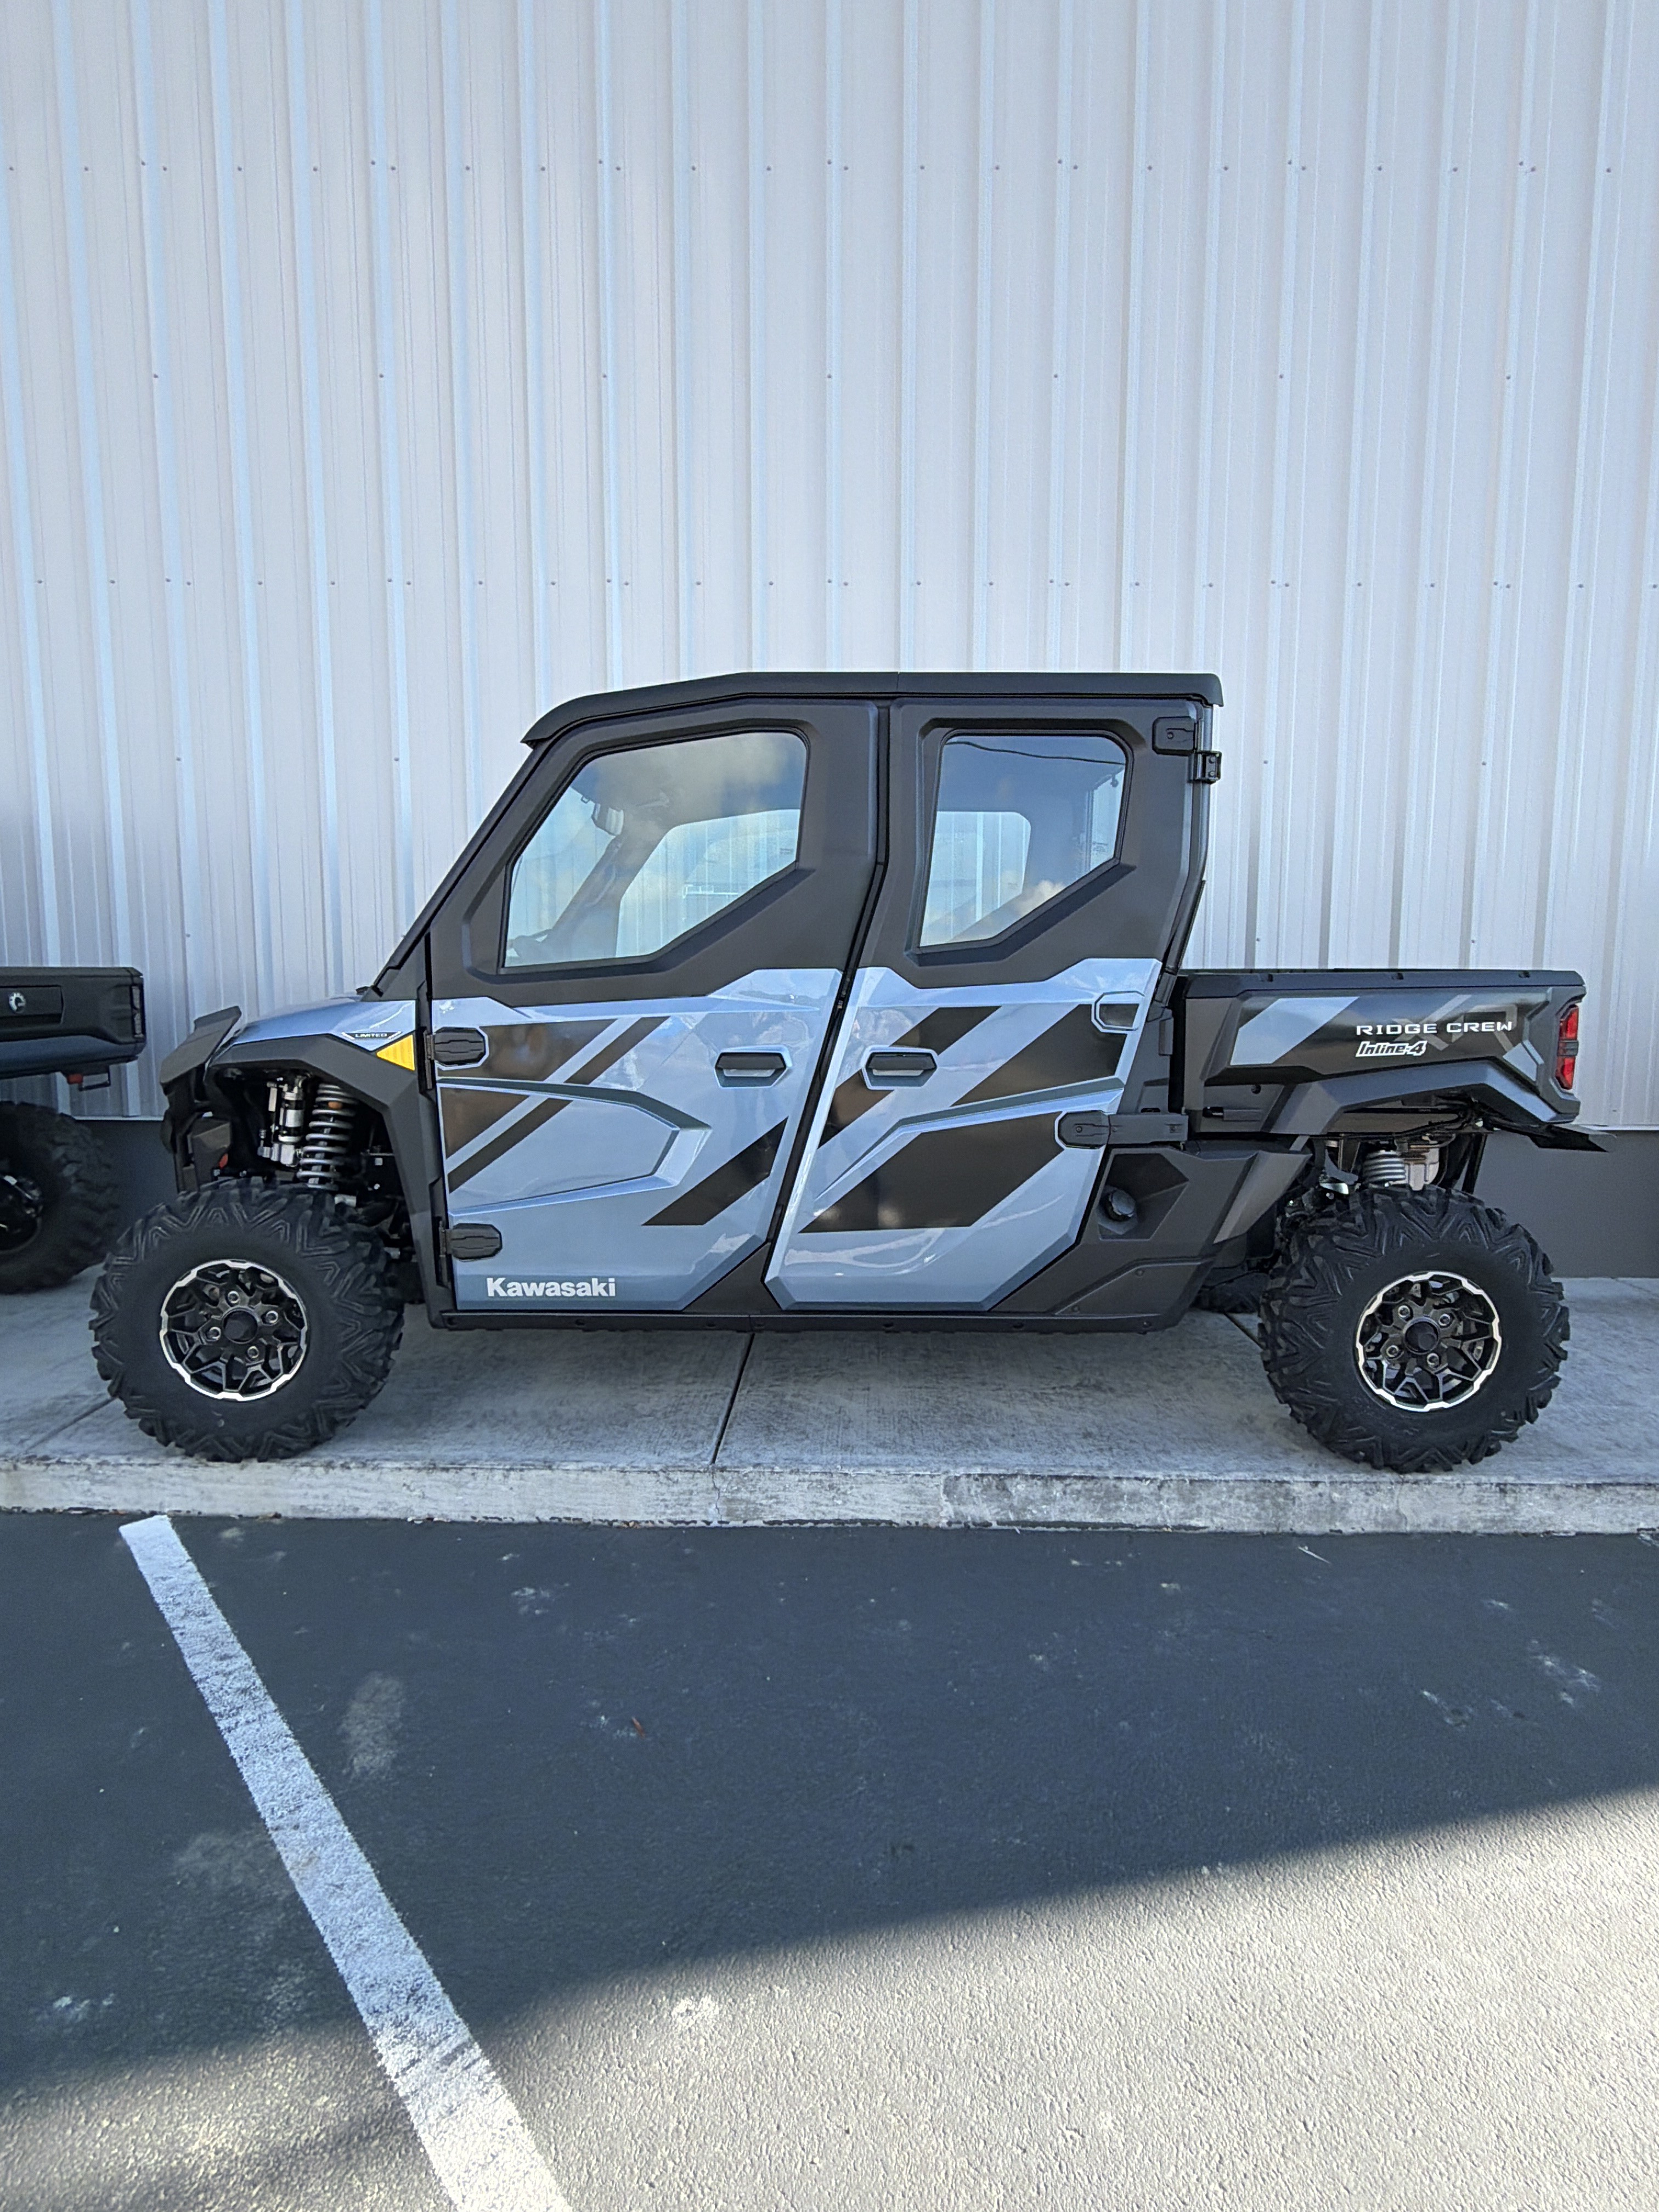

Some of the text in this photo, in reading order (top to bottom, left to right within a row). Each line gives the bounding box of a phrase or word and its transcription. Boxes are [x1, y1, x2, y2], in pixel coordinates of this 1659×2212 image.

[1356, 1021, 1512, 1036] RIDGE CREW
[1355, 1040, 1427, 1057] Inline-4
[486, 1277, 616, 1297] Kawasaki
